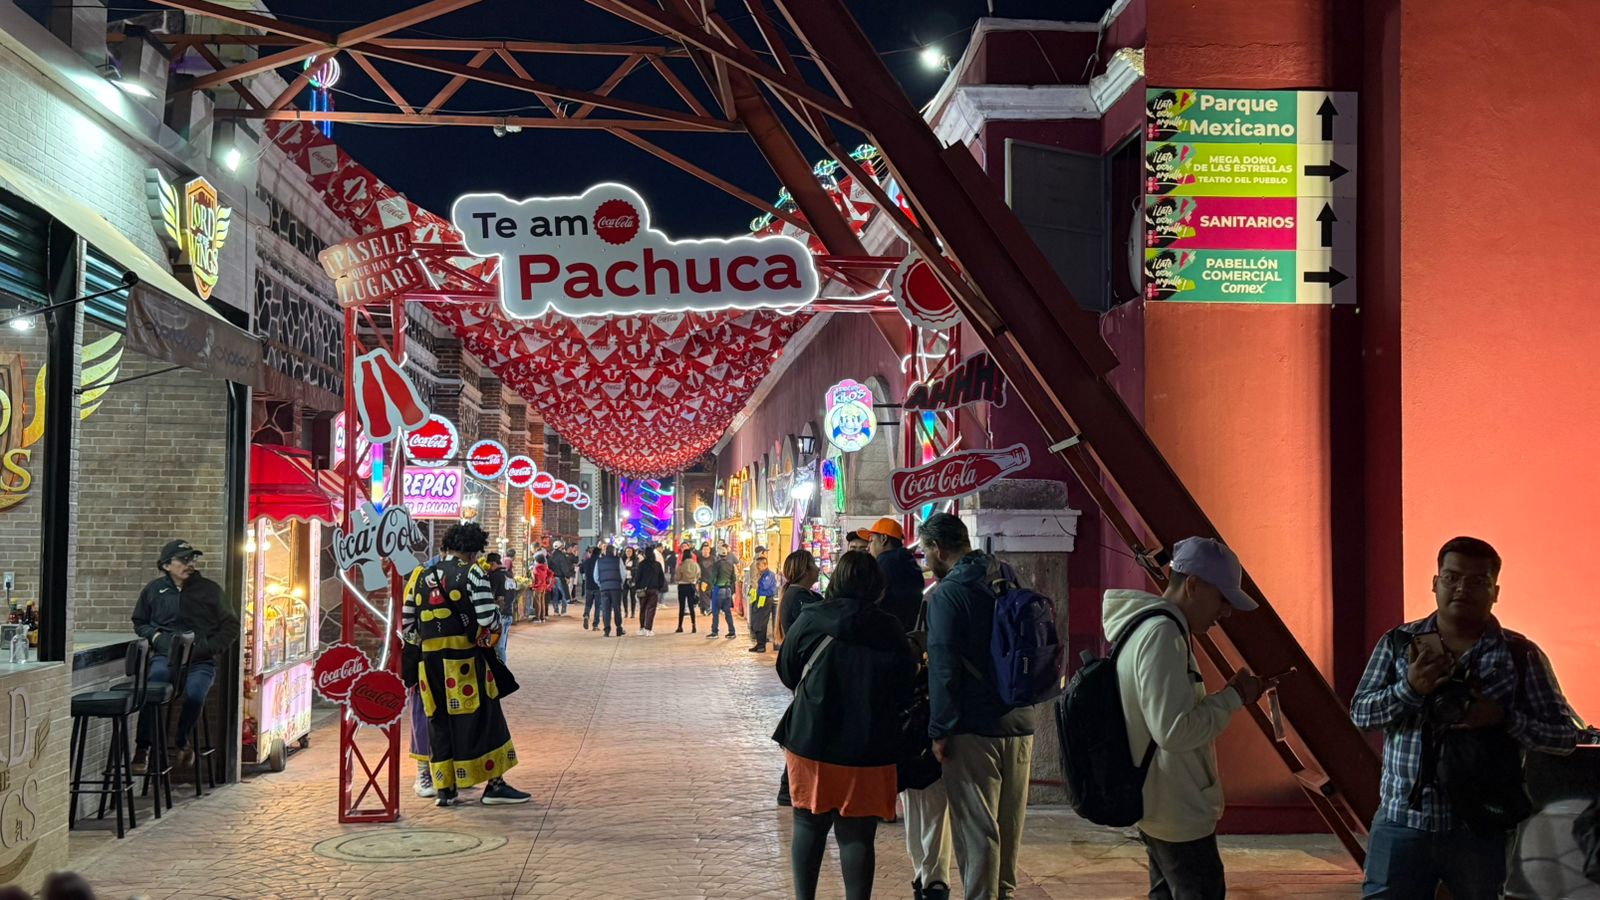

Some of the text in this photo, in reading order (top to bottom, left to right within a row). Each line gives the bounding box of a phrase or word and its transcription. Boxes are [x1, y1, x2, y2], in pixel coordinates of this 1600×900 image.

[1200, 95, 1278, 114] Parque
[1190, 118, 1295, 137] Mexicano
[1193, 164, 1293, 173] DE LAS ESTRELLAS
[1209, 155, 1277, 165] MEGA DOMO
[1199, 176, 1232, 184] TEATRO
[190, 195, 216, 241] LORD
[473, 212, 517, 239] Te
[530, 213, 588, 237] am
[1200, 215, 1294, 229] SANITARIOS
[186, 229, 219, 275] WINGS
[324, 232, 407, 274] ¡PÁSELE
[352, 259, 391, 279] QUE HAY
[1206, 257, 1278, 271] PABELLÓN
[341, 263, 417, 303] LUGAR!
[518, 248, 802, 301] Pachuca
[1202, 270, 1282, 282] COMERCIAL
[1221, 282, 1267, 294] Comex
[403, 472, 457, 498] REPAS
[900, 455, 979, 503] Coca-Cola
[335, 507, 423, 571] Coca-Cola
